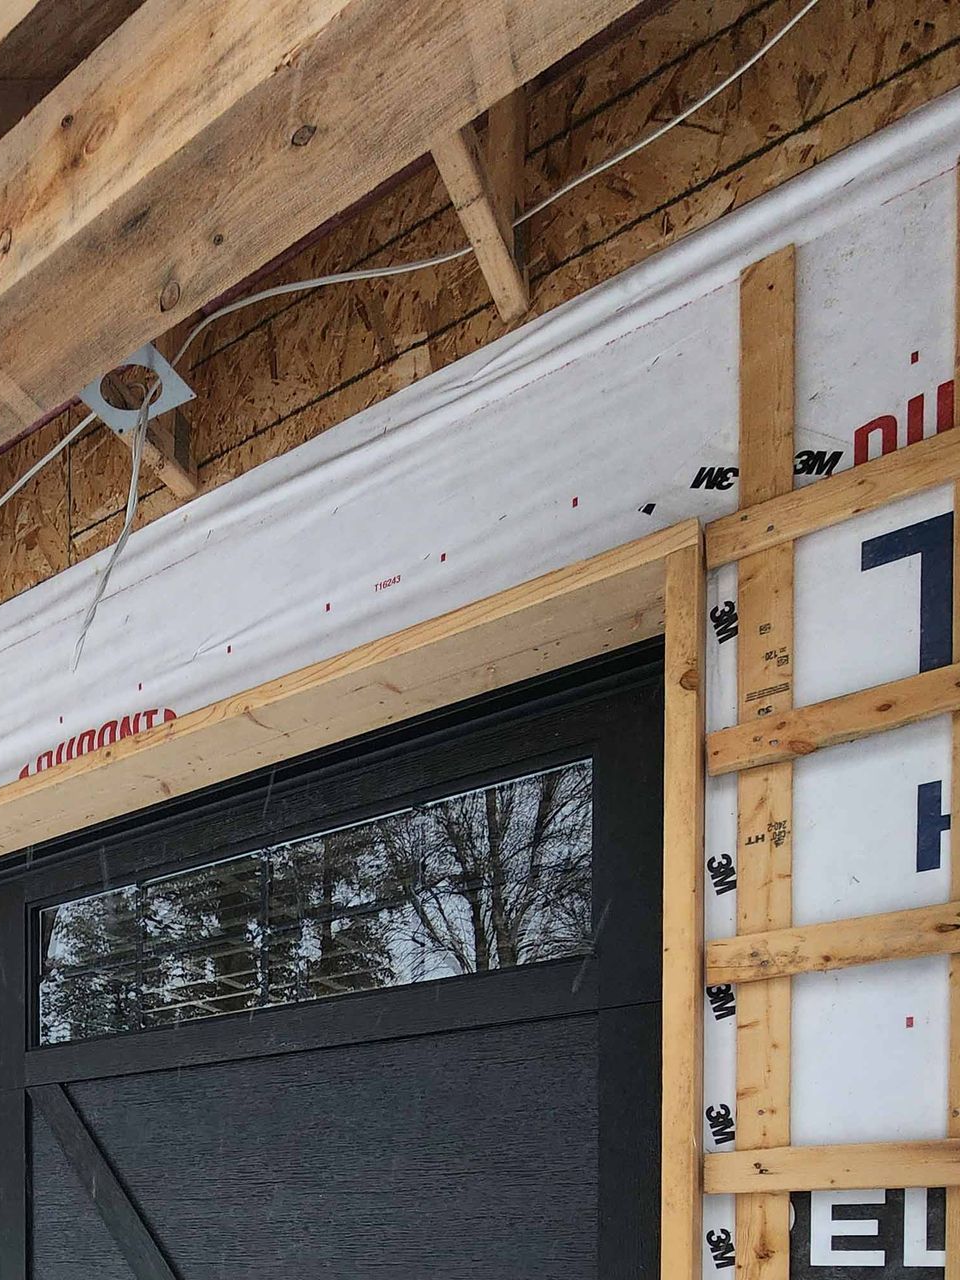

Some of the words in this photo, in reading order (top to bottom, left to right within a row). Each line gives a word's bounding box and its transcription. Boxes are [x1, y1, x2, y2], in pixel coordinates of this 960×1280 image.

[793, 450, 843, 476] 3M
[374, 574, 401, 592] T16243
[709, 600, 739, 645] 3M
[707, 853, 737, 896] 3M
[706, 983, 736, 1021] 3M
[705, 1103, 735, 1145] 3M
[706, 1228, 735, 1270] 3M
